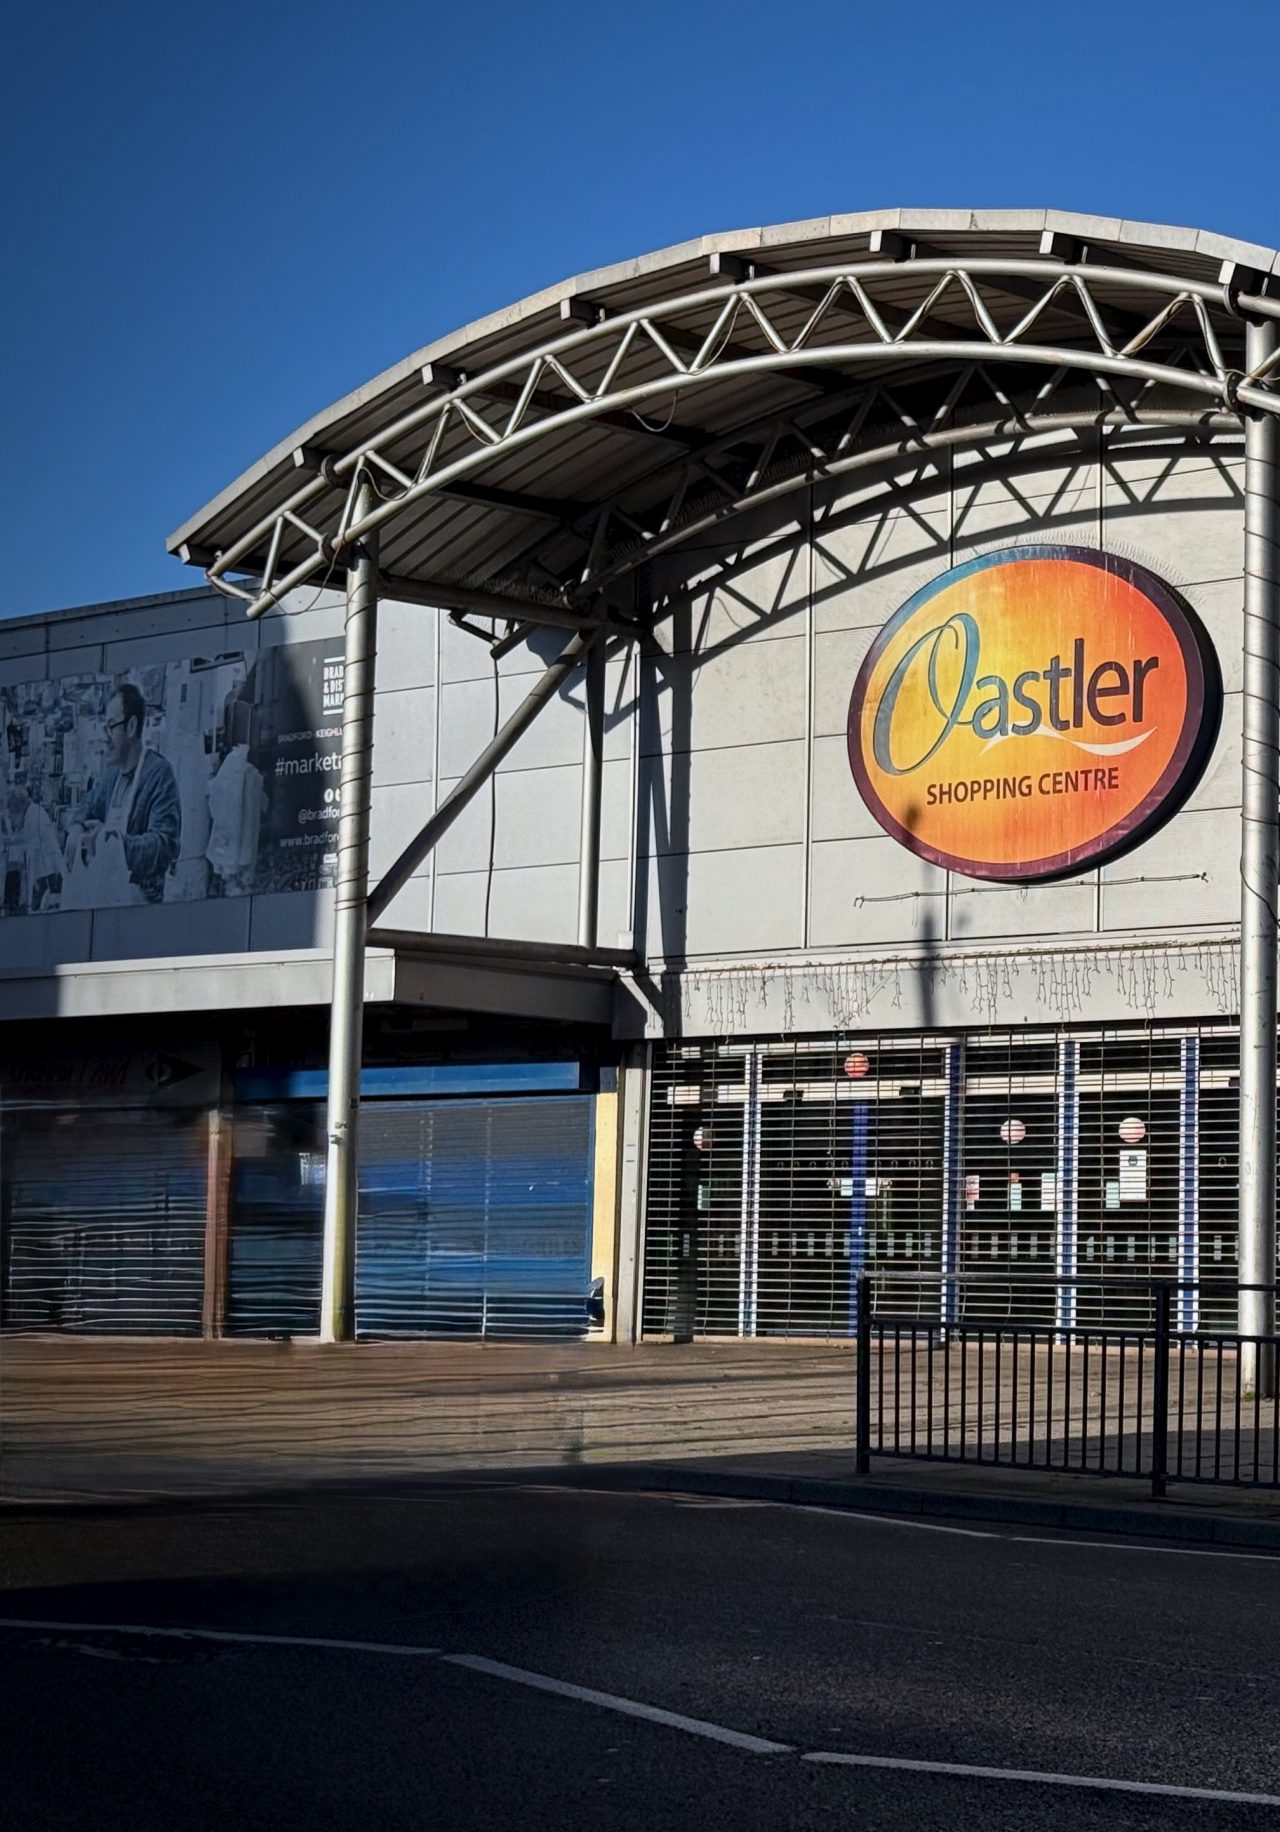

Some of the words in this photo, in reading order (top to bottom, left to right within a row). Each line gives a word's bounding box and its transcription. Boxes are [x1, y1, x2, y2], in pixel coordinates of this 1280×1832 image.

[330, 679, 345, 693] DIS
[872, 612, 1159, 776] Oastler
[274, 752, 342, 777] #market
[926, 774, 1033, 806] SHOPPING
[1037, 766, 1120, 796] CENTRE
